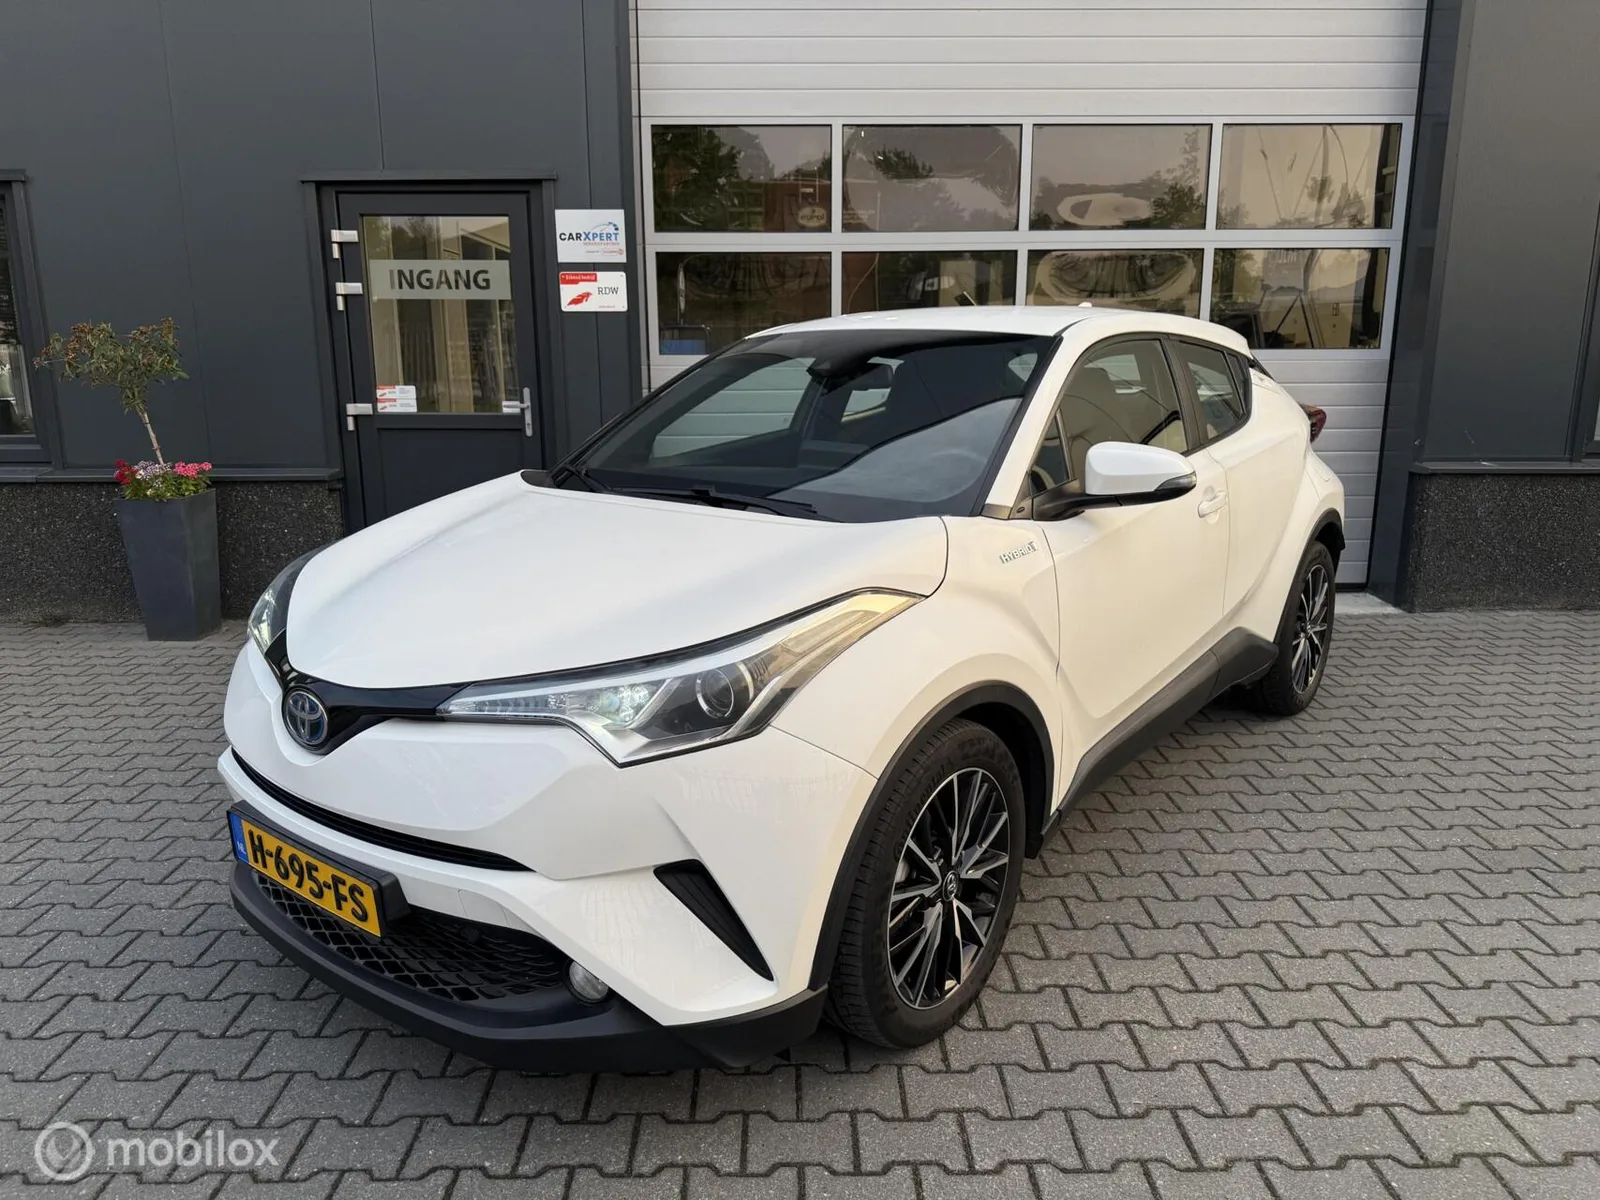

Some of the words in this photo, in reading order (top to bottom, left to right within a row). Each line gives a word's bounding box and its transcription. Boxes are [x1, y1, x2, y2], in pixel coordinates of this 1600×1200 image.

[559, 231, 619, 242] CARXPERT
[388, 269, 491, 290] INGANG
[597, 286, 619, 295] RDW
[999, 540, 1037, 564] HYBRID
[247, 829, 369, 923] H-695-FS
